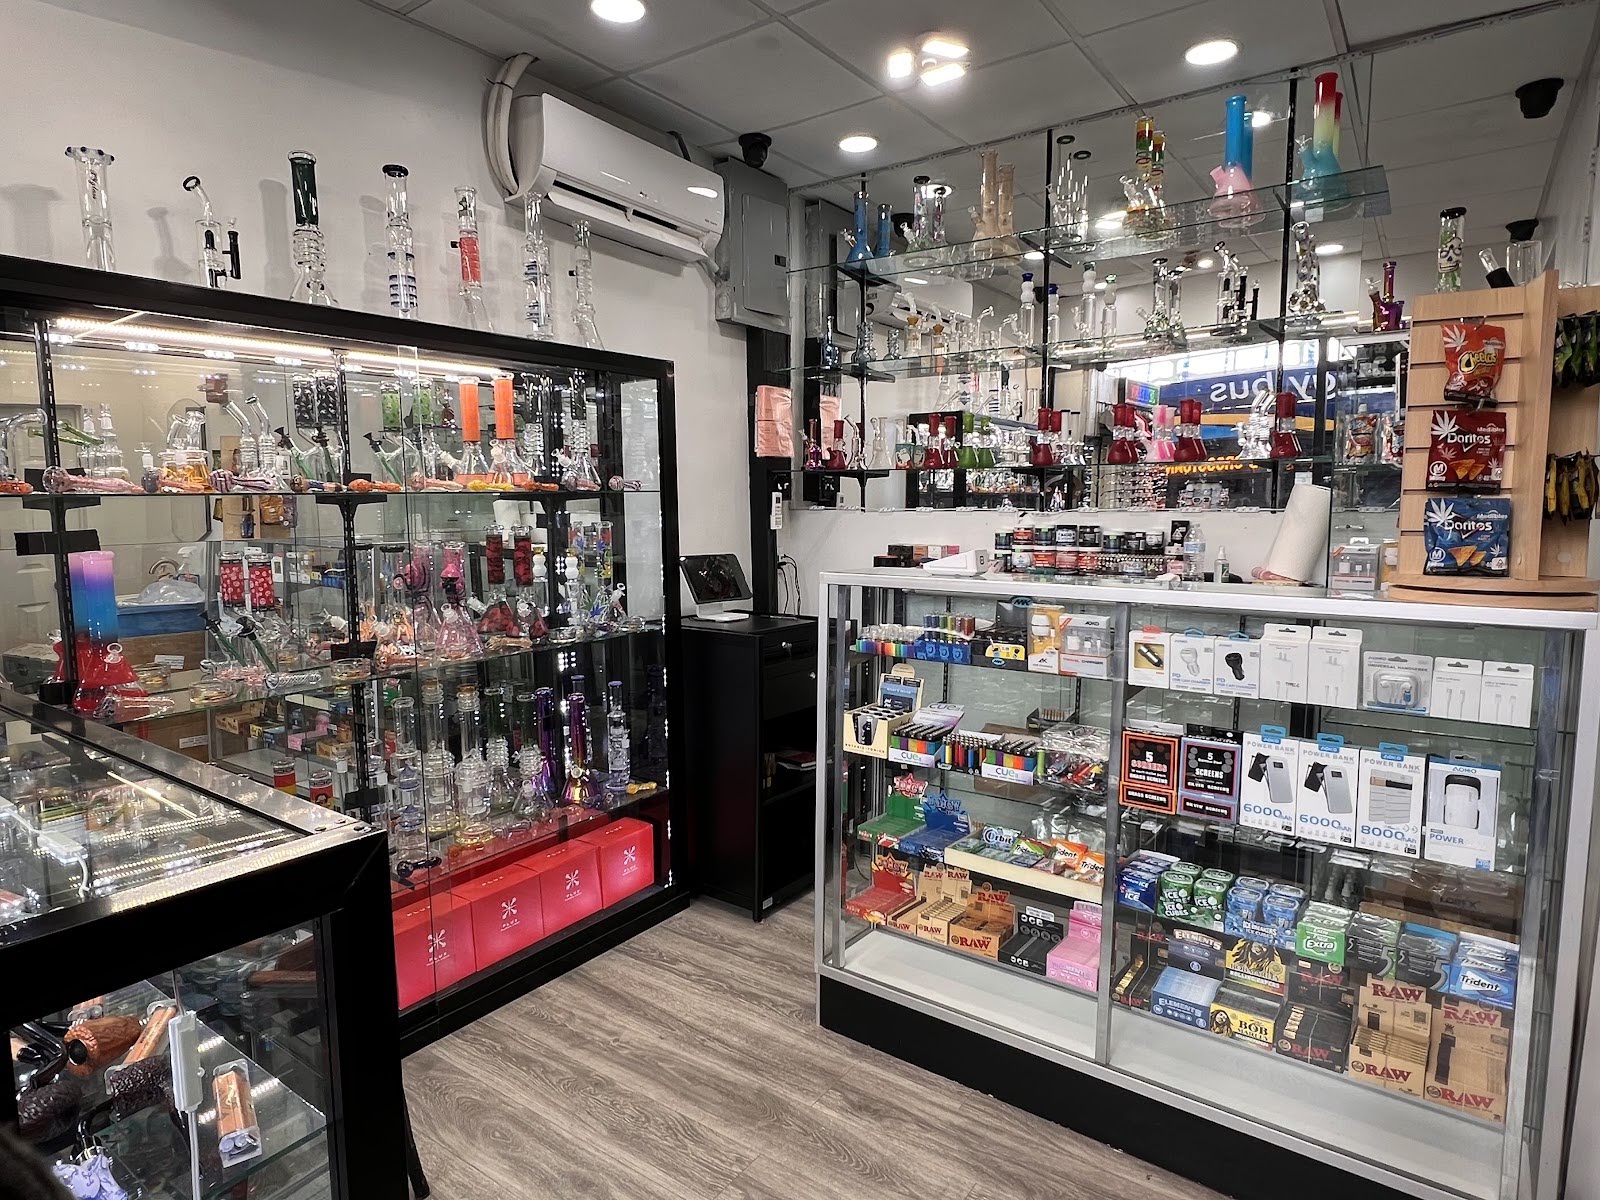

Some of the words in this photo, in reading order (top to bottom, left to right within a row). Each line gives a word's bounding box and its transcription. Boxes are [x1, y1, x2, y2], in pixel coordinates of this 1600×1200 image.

[1460, 351, 1497, 373] Cheetos
[1447, 432, 1491, 444] Doritos
[1444, 520, 1492, 531] Doritos
[1247, 741, 1272, 750] POWER
[1274, 745, 1295, 753] BANK
[1145, 751, 1153, 762] 5
[1207, 752, 1214, 760] 5
[1303, 750, 1330, 759] POWER
[1333, 753, 1354, 761] BANK
[1364, 758, 1394, 767] POWER
[1396, 763, 1420, 771] BANK
[1195, 768, 1223, 779] SCREENS
[983, 827, 1013, 844] Orbit
[1429, 833, 1465, 844] POWER
[924, 871, 943, 879] RAW
[947, 869, 968, 879] RAW
[977, 892, 1007, 902] RAW
[1125, 892, 1140, 902] ICE
[1163, 890, 1179, 899] ICE
[1195, 897, 1209, 907] ICE
[893, 922, 910, 931] RAW
[1020, 914, 1044, 927] OCB
[924, 924, 942, 934] RAW
[959, 936, 991, 950] RAW
[1175, 931, 1222, 951] ELEMENTS
[1306, 940, 1334, 949] Extra
[1010, 956, 1029, 968] OCB
[1377, 946, 1397, 977] 5
[1429, 959, 1451, 990] 5
[1460, 974, 1500, 992] Trident
[1371, 983, 1424, 1001] RAW
[1159, 998, 1202, 1017] ELEMENTS
[1443, 1006, 1499, 1025] RAW
[1239, 1020, 1268, 1036] BOB
[1291, 1043, 1329, 1060] RAW
[1365, 1064, 1412, 1083] RAW
[1440, 1087, 1495, 1109] RAW
